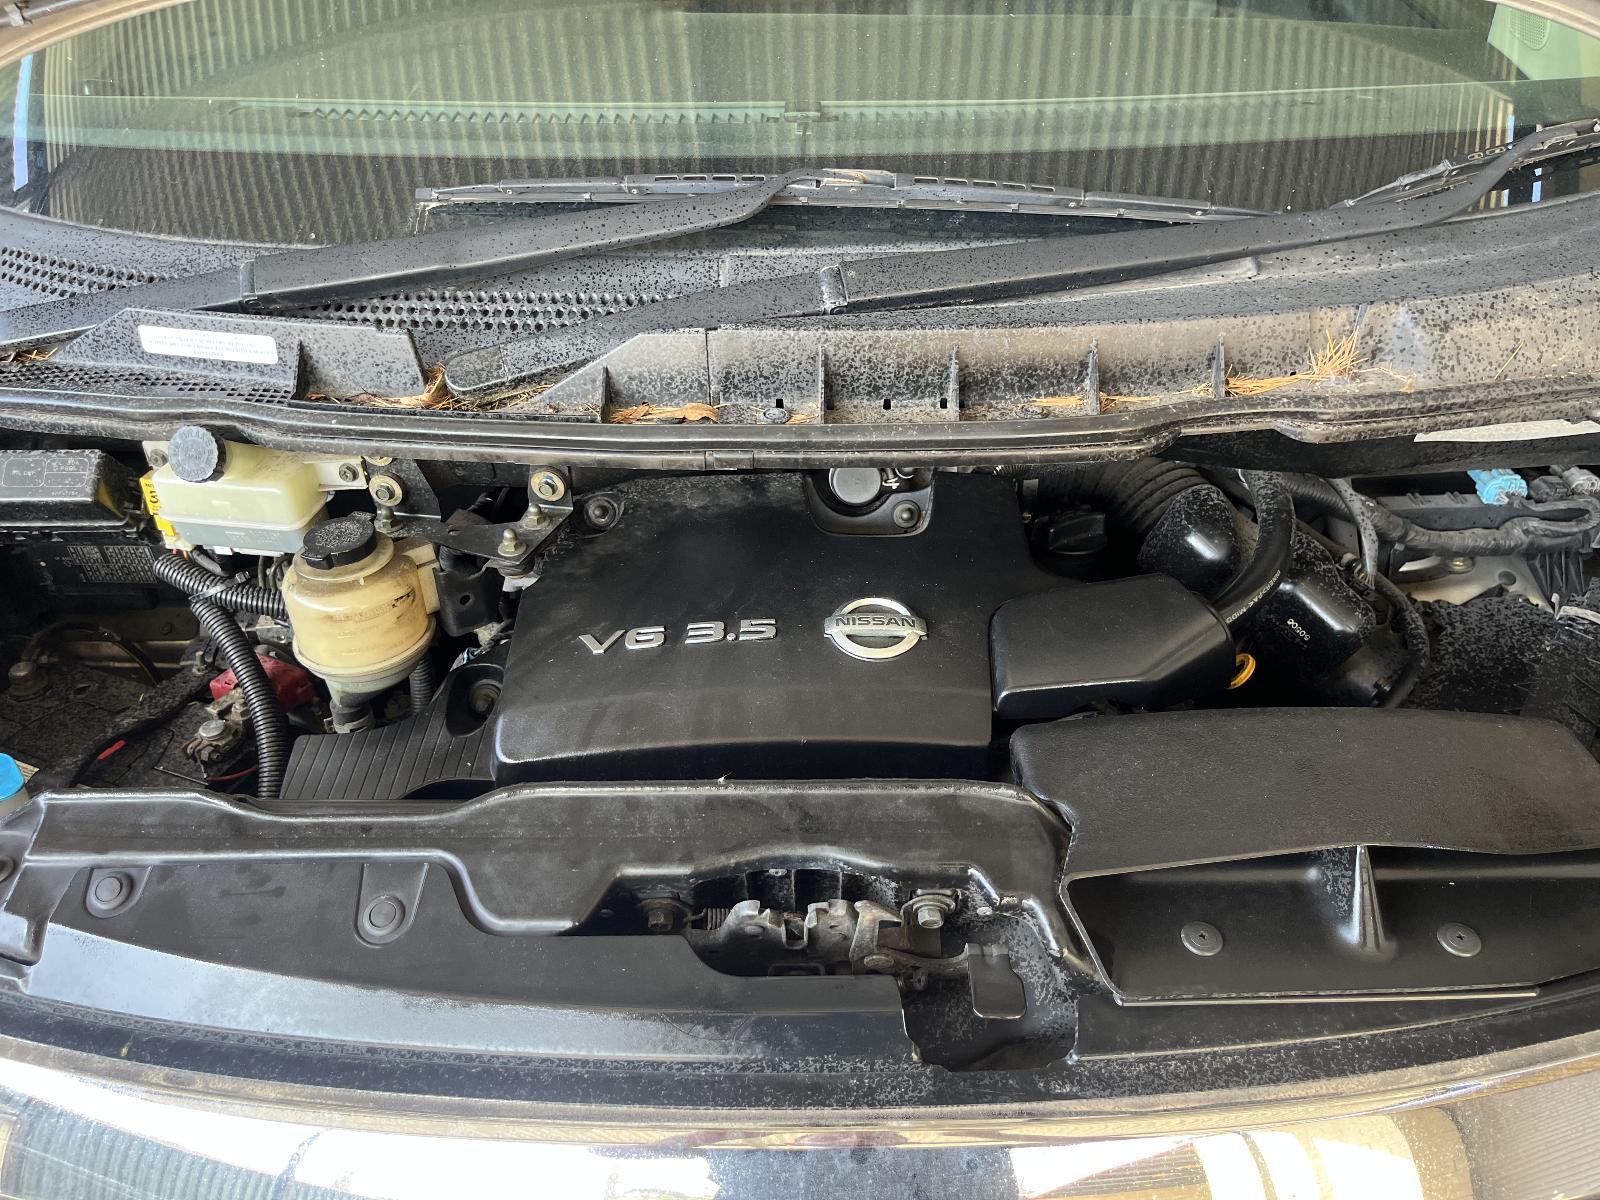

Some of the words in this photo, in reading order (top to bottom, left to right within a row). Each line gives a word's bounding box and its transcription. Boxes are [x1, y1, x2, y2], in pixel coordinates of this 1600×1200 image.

[835, 615, 916, 628] NISSAN
[578, 625, 665, 655] V6
[684, 618, 777, 645] 3.5
